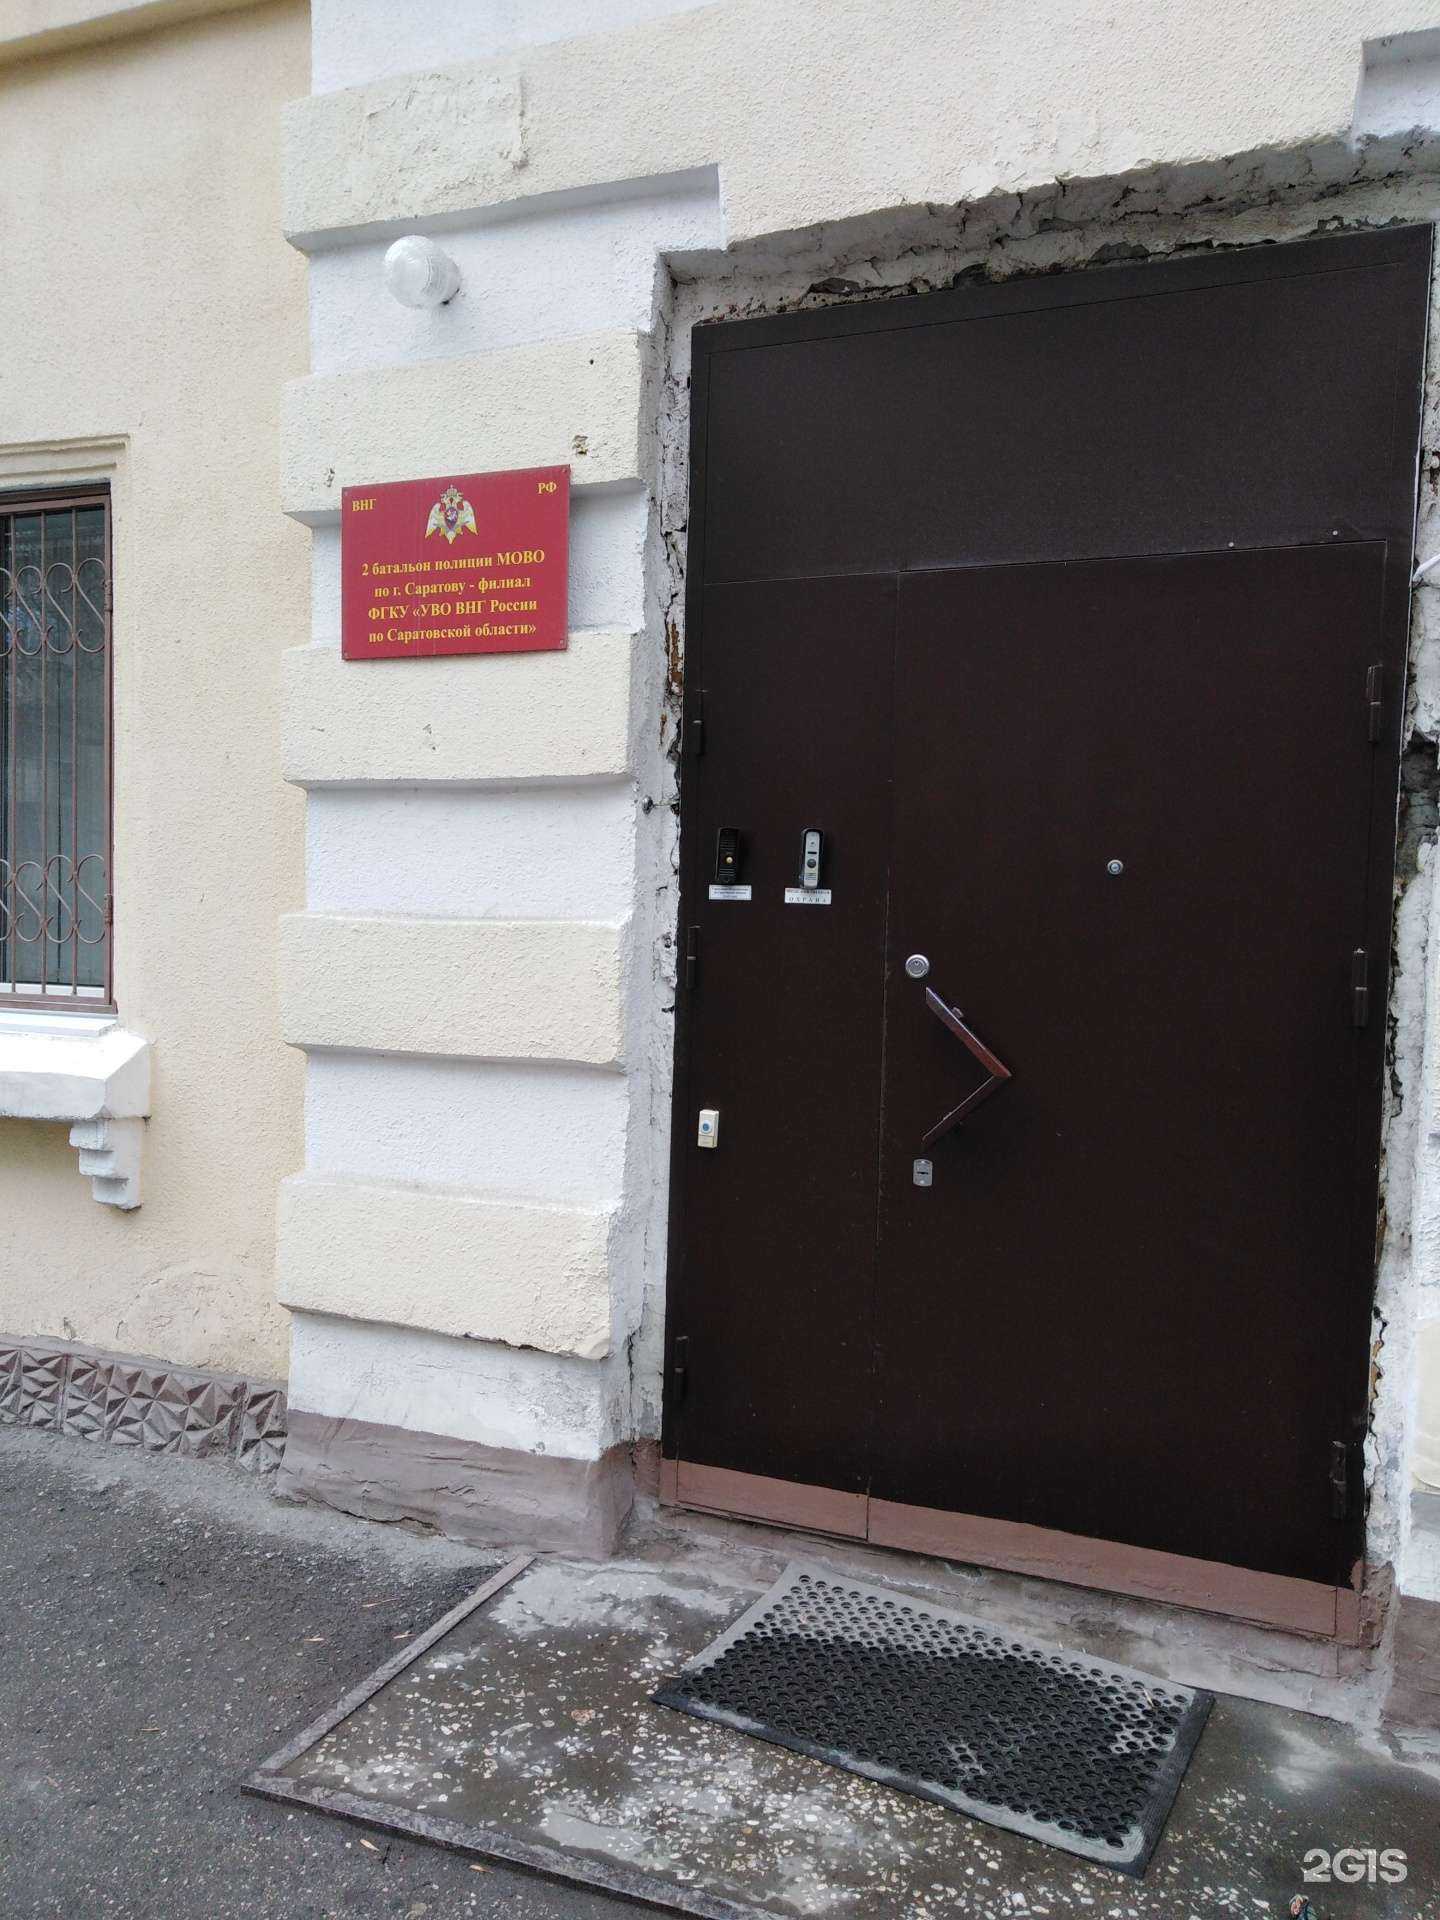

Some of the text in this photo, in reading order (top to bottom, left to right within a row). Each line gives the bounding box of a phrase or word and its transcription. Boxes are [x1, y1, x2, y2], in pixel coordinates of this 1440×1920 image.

[537, 482, 556, 494] РФ
[352, 499, 376, 512] ВНГ
[361, 549, 545, 576] 2 батальон полиции МОВО
[374, 587, 389, 597] по
[393, 586, 401, 596] г.
[404, 582, 466, 597] Саратову
[478, 577, 531, 593] филиал
[368, 599, 537, 620] ФГКУ «УВО ВНГ России
[368, 623, 536, 644] по Саратовской области»
